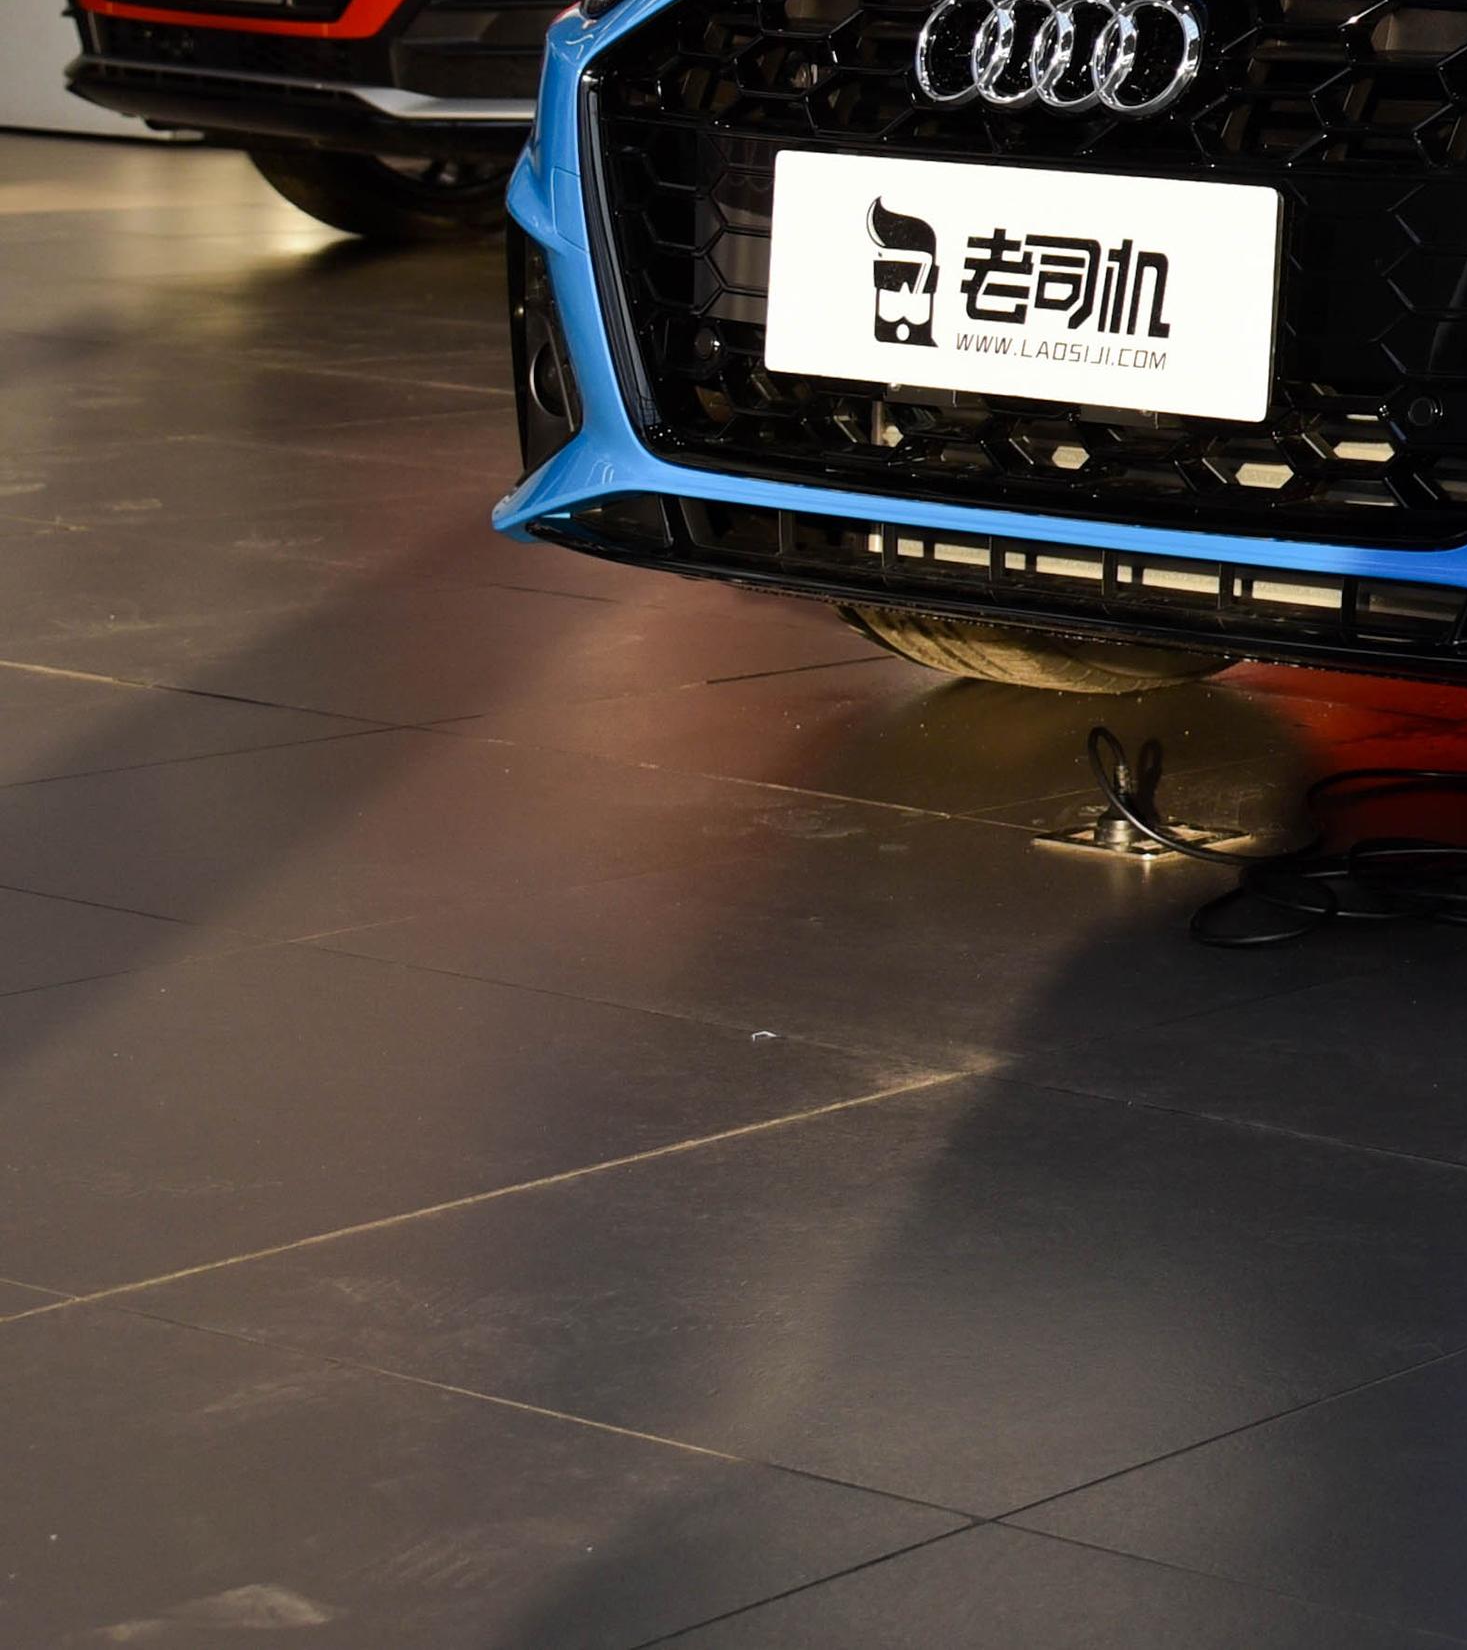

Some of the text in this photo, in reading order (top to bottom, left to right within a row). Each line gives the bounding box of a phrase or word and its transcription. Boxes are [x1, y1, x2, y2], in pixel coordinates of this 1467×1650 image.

[960, 228, 1170, 338] 老司机
[956, 333, 1167, 370] WWW.LAOSIJI.COM
